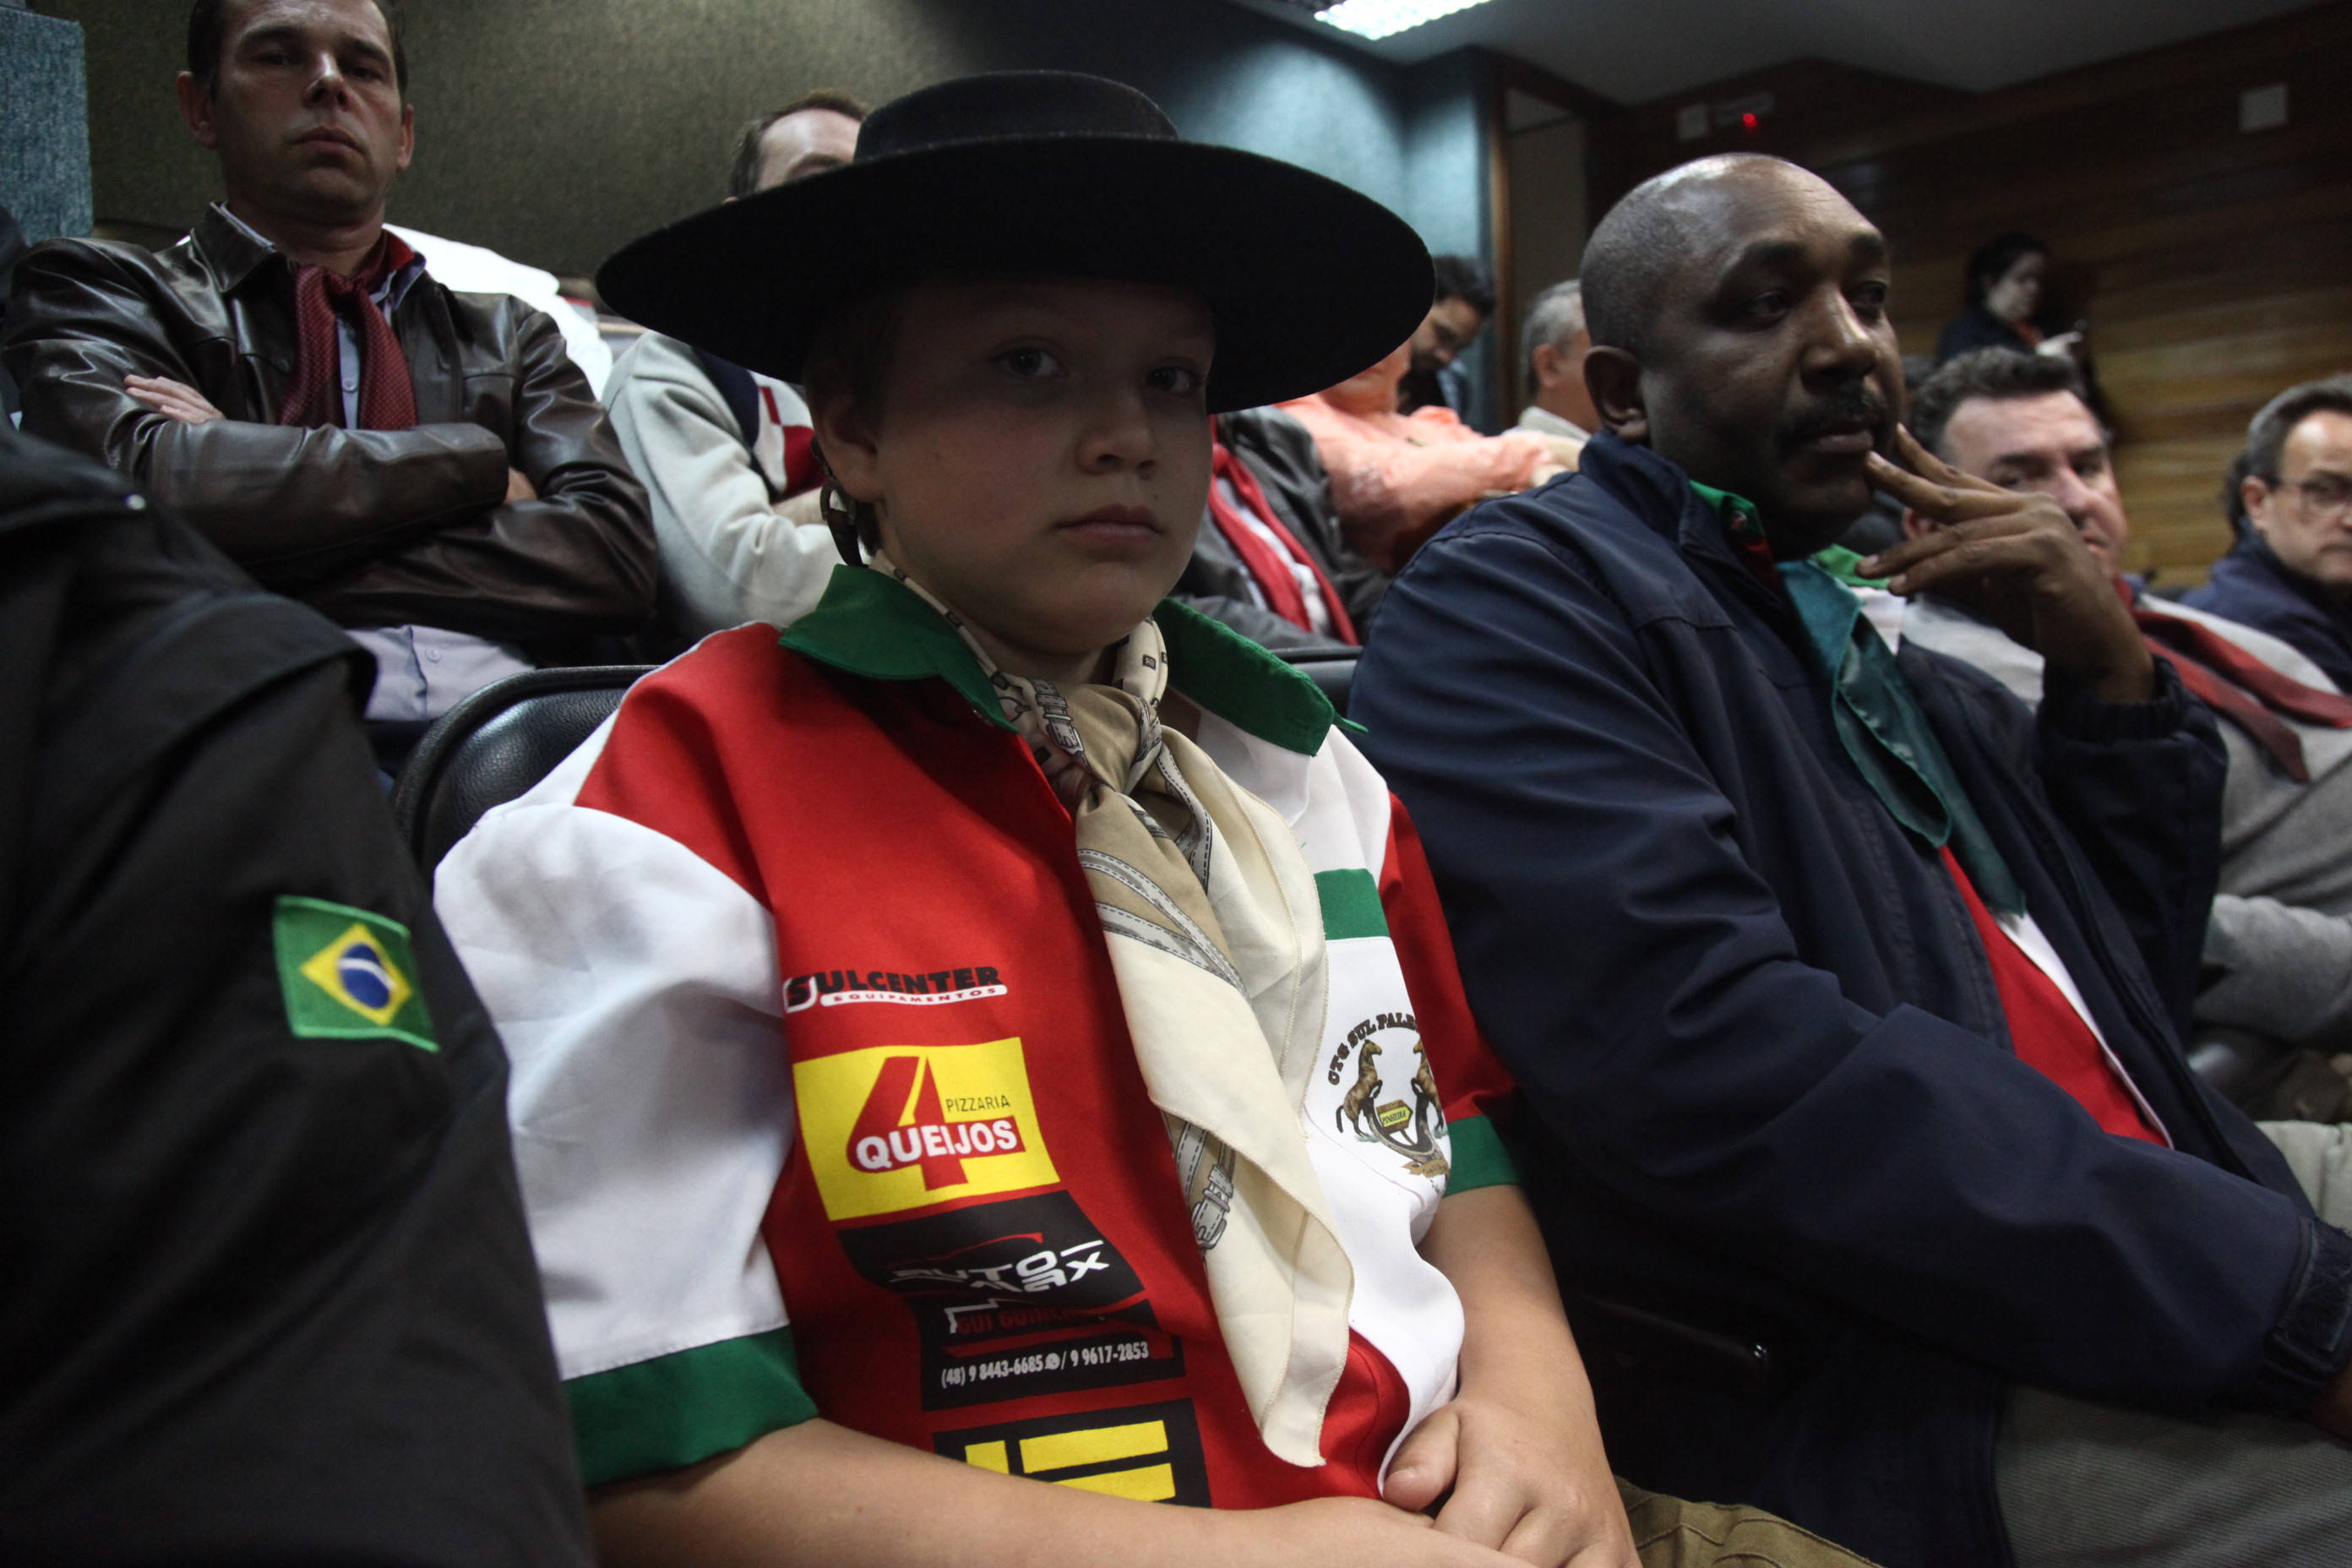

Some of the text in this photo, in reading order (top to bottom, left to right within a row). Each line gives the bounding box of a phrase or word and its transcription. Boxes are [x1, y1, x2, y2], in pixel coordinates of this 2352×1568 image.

[787, 966, 1003, 1006] SULCENTER
[833, 988, 996, 1003] EQUIPAMENTOS
[1347, 1019, 1377, 1048] SUL
[946, 1095, 1010, 1113] PIZZARIA
[856, 1120, 1018, 1170] QUEIJOS
[941, 1367, 966, 1389] (48)
[968, 1365, 976, 1381] 9
[979, 1354, 1043, 1380] 8443-6685
[1070, 1350, 1078, 1367] 9
[1082, 1342, 1149, 1366] 9617-2853
